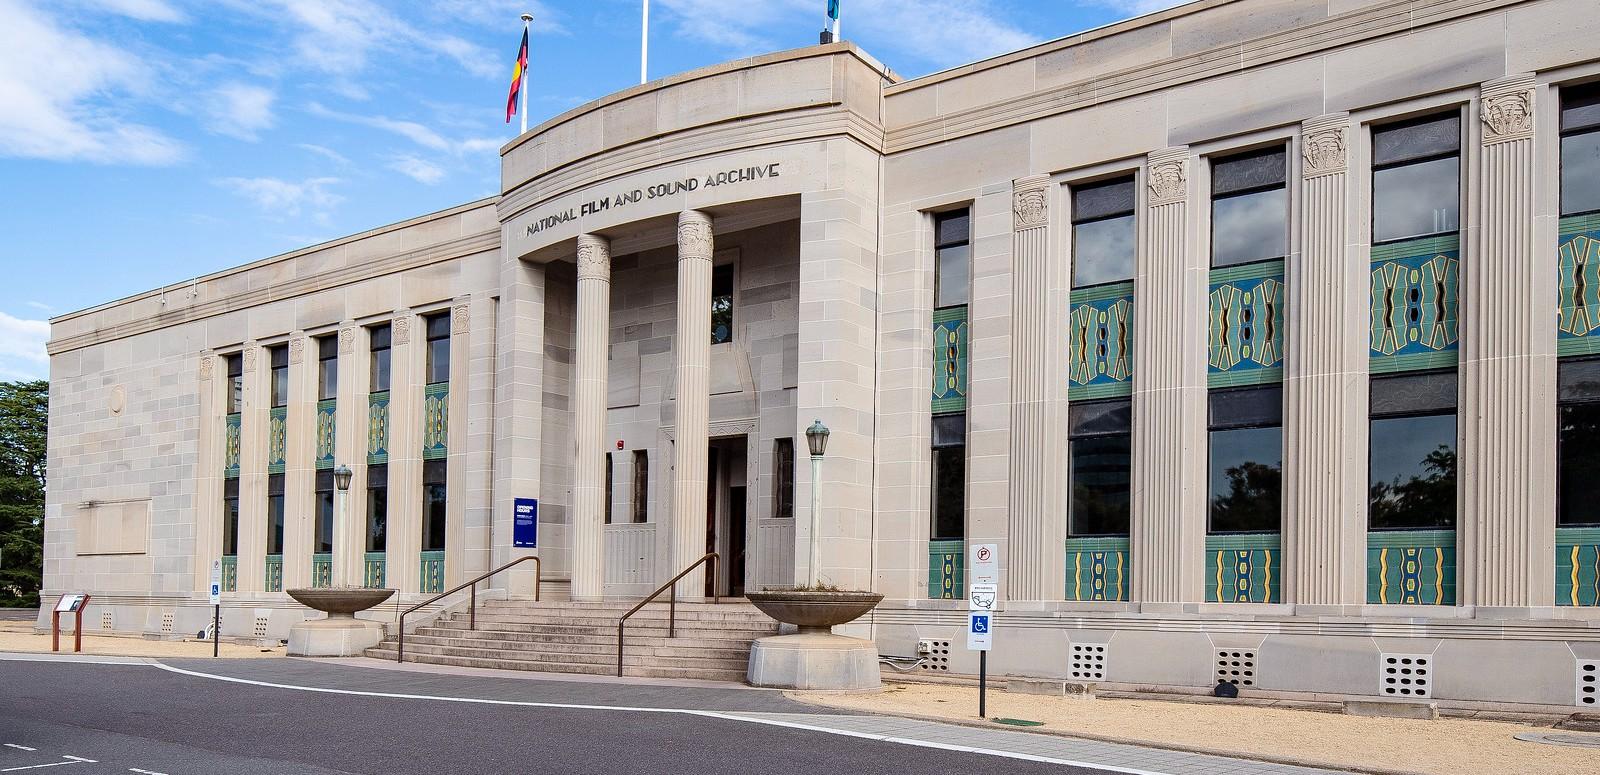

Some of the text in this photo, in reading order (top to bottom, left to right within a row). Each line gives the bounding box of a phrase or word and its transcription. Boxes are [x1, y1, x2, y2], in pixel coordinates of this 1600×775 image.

[526, 163, 780, 236] NATIONAL FILM AND SOUND ARCHIVE
